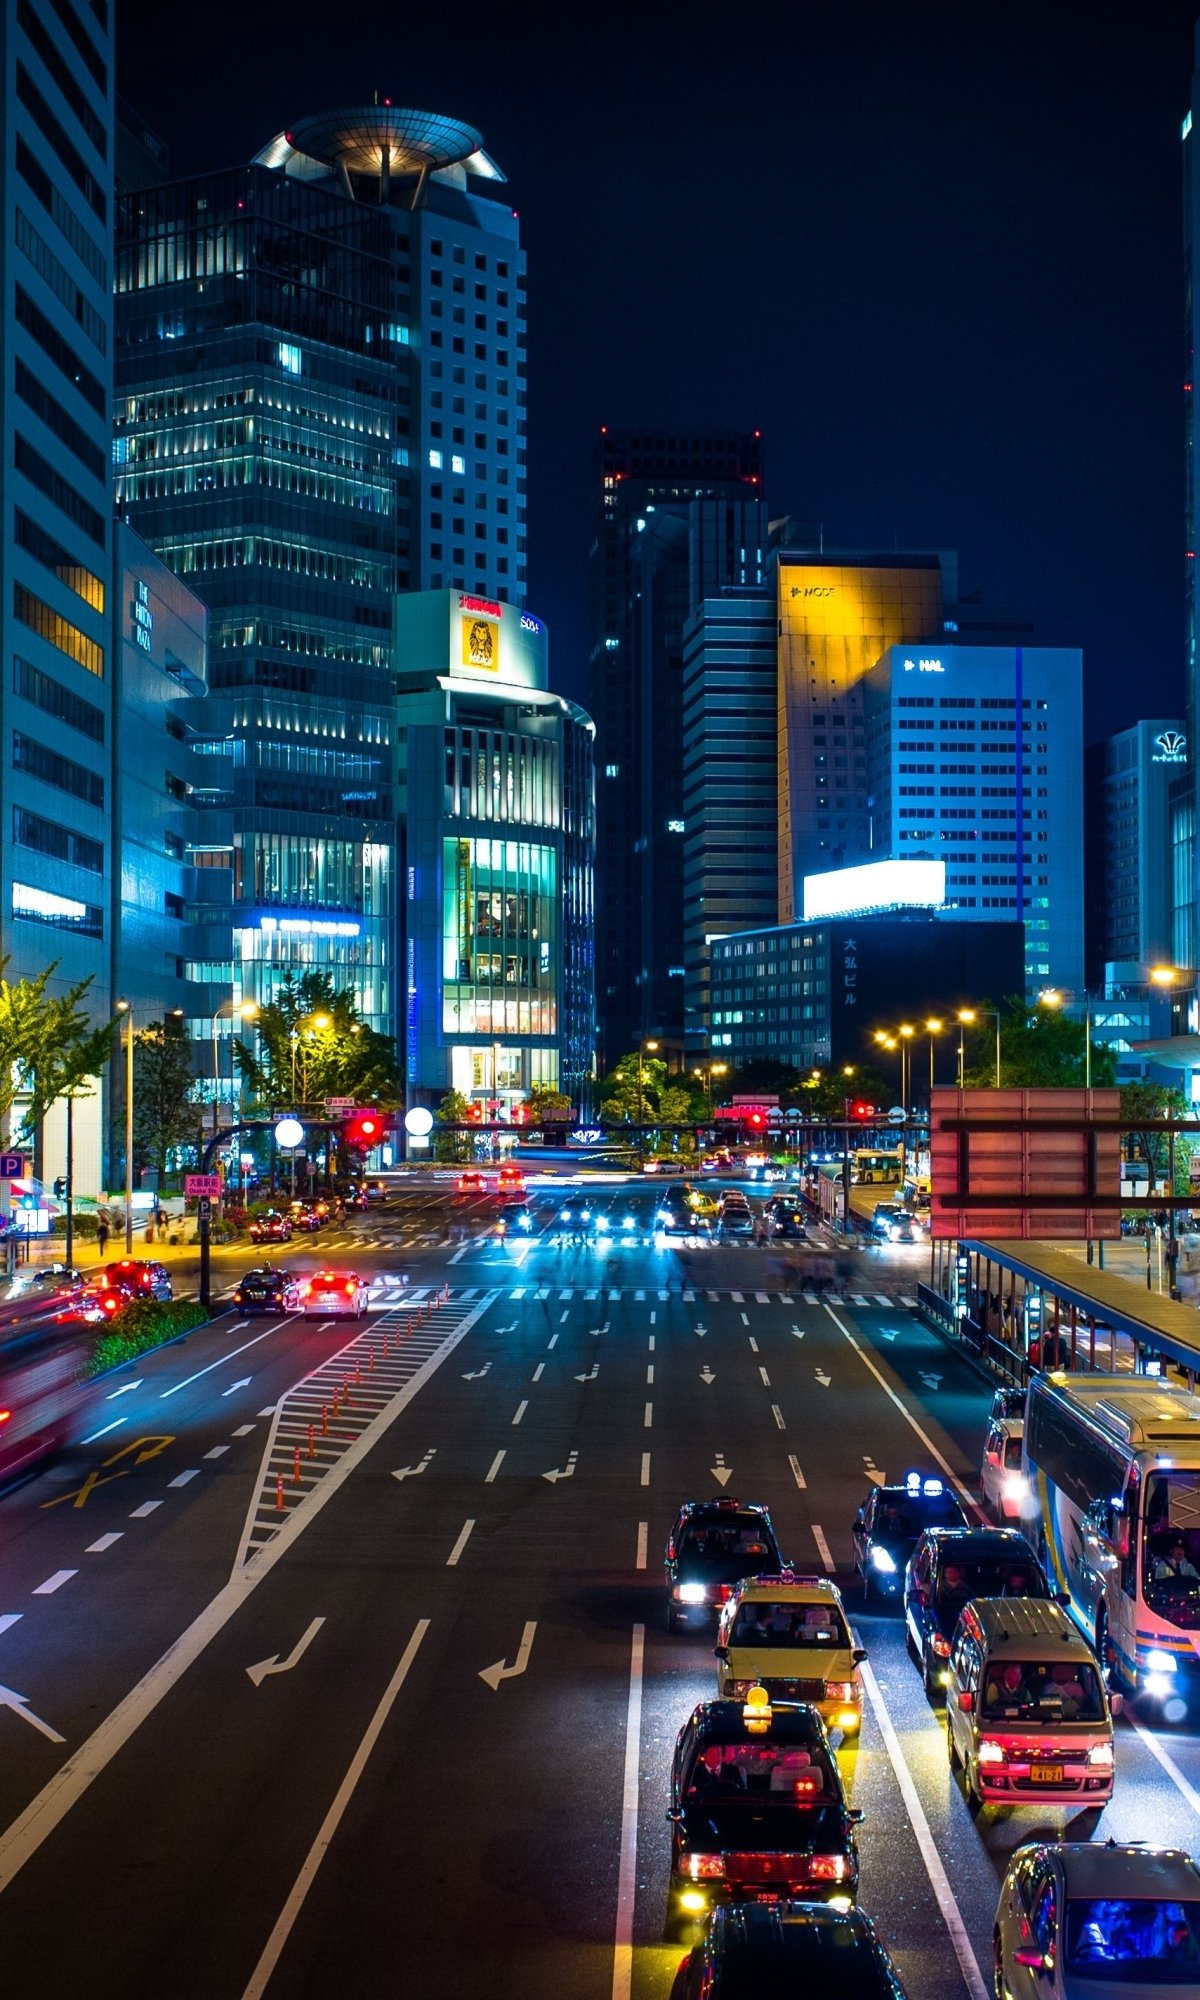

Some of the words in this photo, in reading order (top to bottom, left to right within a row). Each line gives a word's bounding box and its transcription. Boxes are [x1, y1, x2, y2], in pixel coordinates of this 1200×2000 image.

[804, 587, 835, 597] MODE
[919, 659, 945, 672] HAL
[844, 938, 857, 1005] 大弘ビル
[6, 1158, 18, 1175] P
[201, 1202, 209, 1212] P
